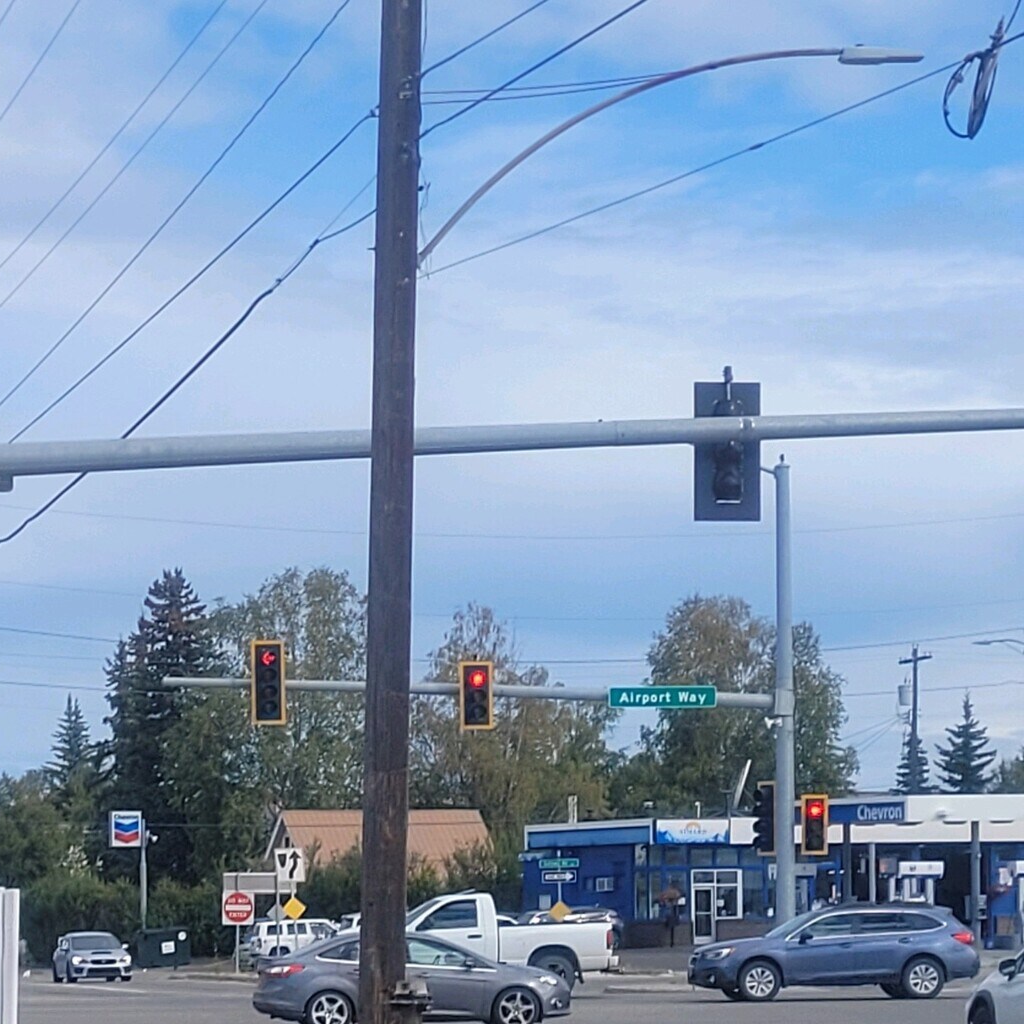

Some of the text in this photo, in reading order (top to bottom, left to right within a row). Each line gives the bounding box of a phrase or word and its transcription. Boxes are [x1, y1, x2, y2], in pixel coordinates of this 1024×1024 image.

[619, 691, 706, 705] Airport Way
[857, 804, 903, 821] Chevron
